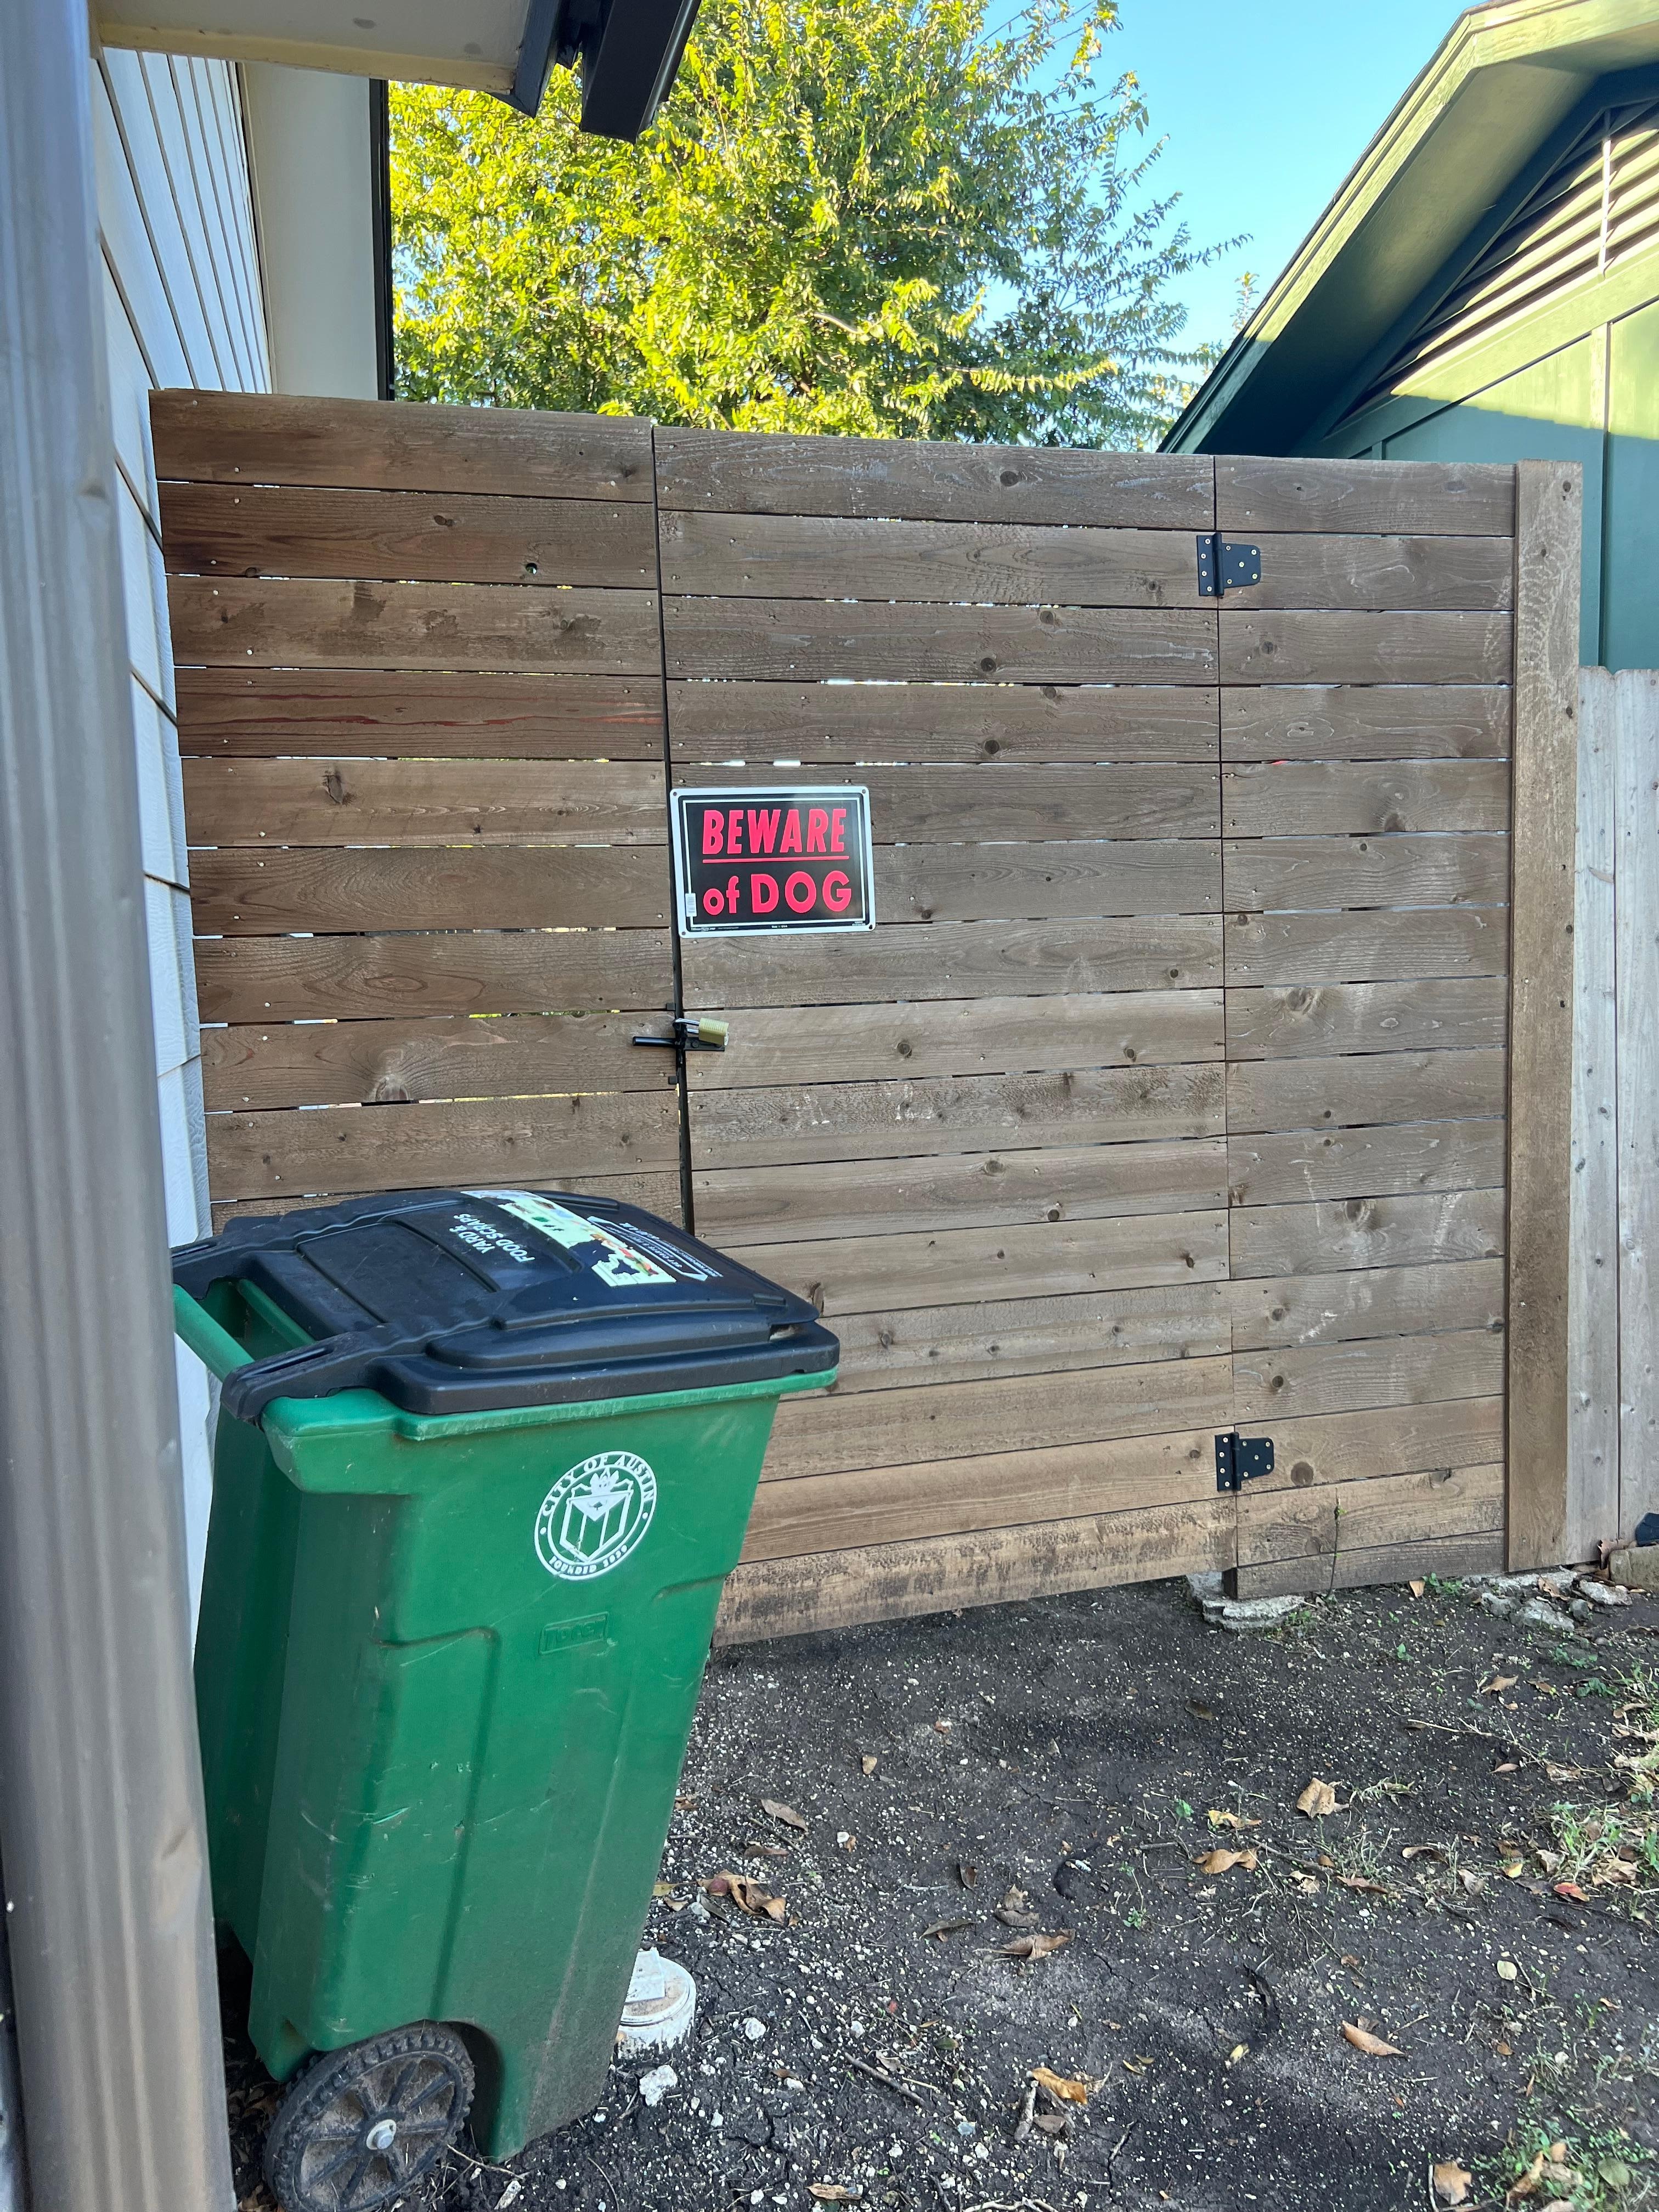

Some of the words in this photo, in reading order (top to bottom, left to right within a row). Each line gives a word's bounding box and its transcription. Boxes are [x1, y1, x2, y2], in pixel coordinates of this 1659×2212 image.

[703, 809, 847, 855] BEWARE
[703, 876, 740, 916] of
[751, 870, 852, 913] DOG
[449, 1224, 467, 1233] &
[453, 1214, 504, 1239] SCRAPS
[459, 1231, 495, 1254] YARD
[495, 1239, 535, 1263] FOOD
[542, 1470, 577, 1517] CITY
[583, 1455, 609, 1473] OF
[613, 1454, 654, 1503] AUSTIN
